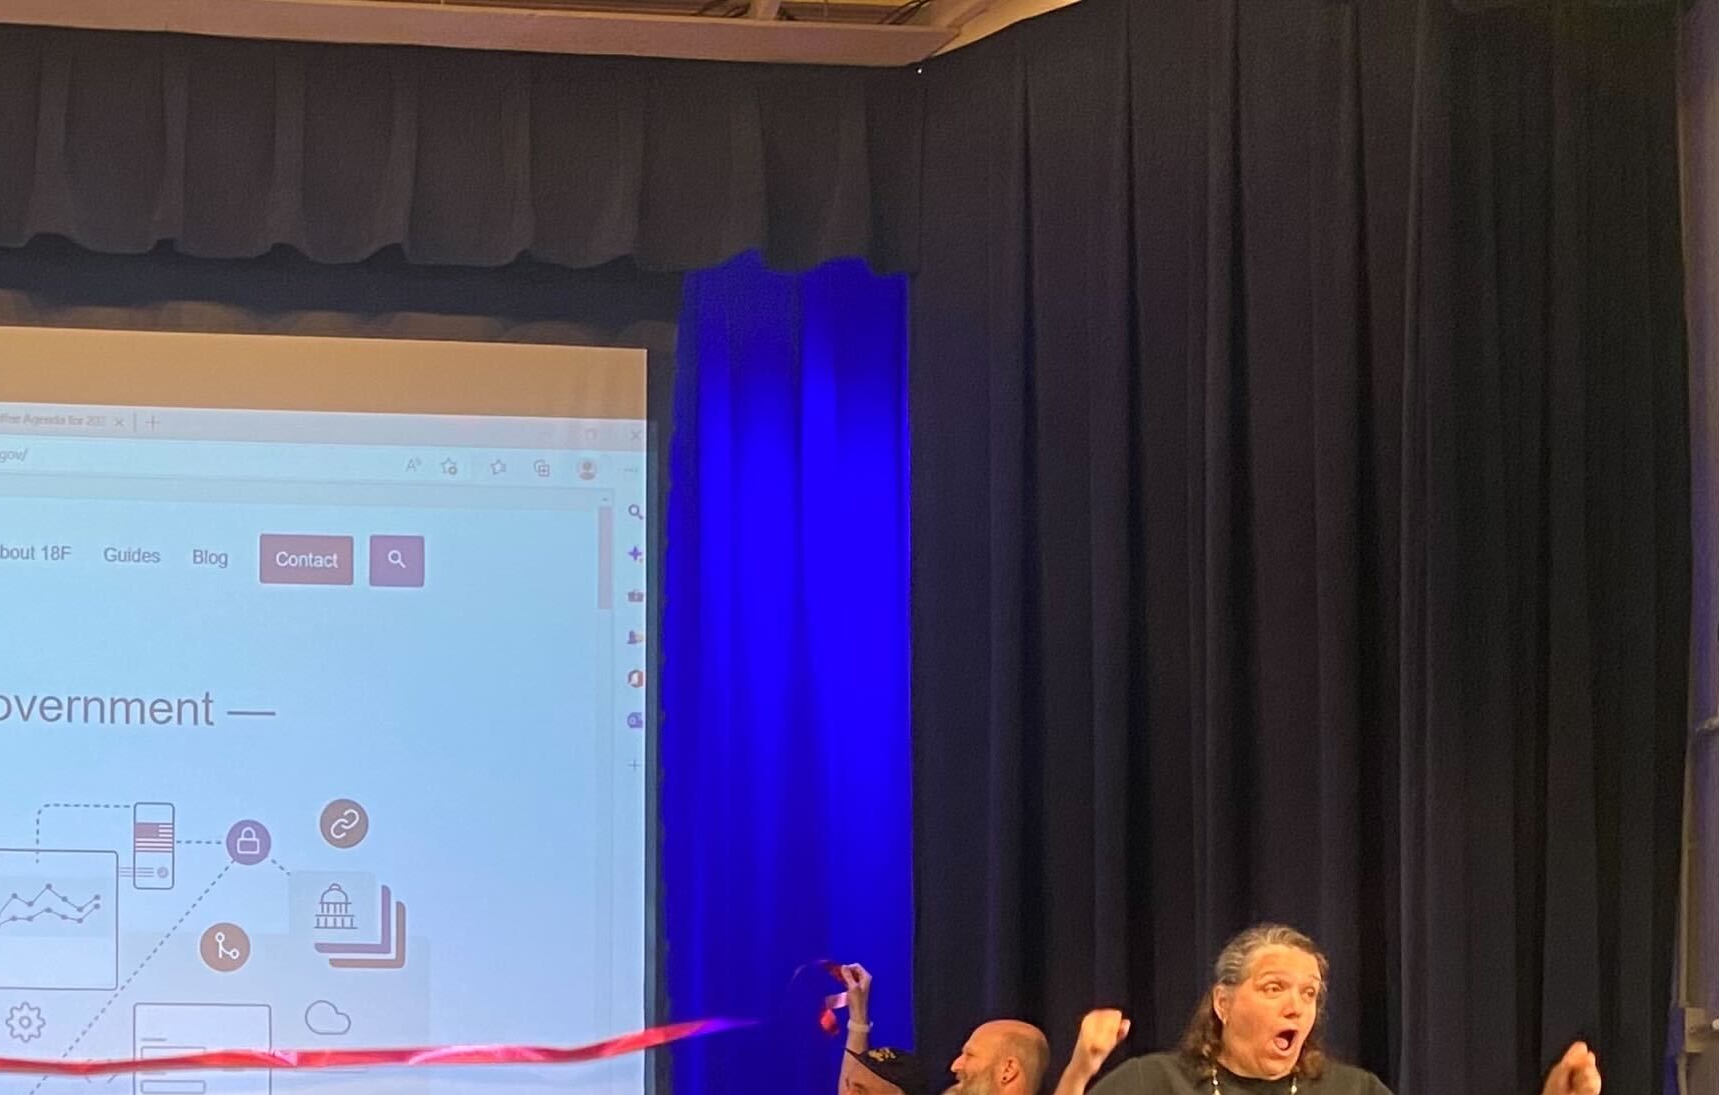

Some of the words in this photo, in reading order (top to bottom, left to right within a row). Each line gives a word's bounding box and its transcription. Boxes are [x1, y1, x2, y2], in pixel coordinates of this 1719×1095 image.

[41, 545, 71, 560] 18F
[104, 547, 161, 563] Guides
[193, 549, 228, 568] Blog
[276, 551, 338, 568] Contact
